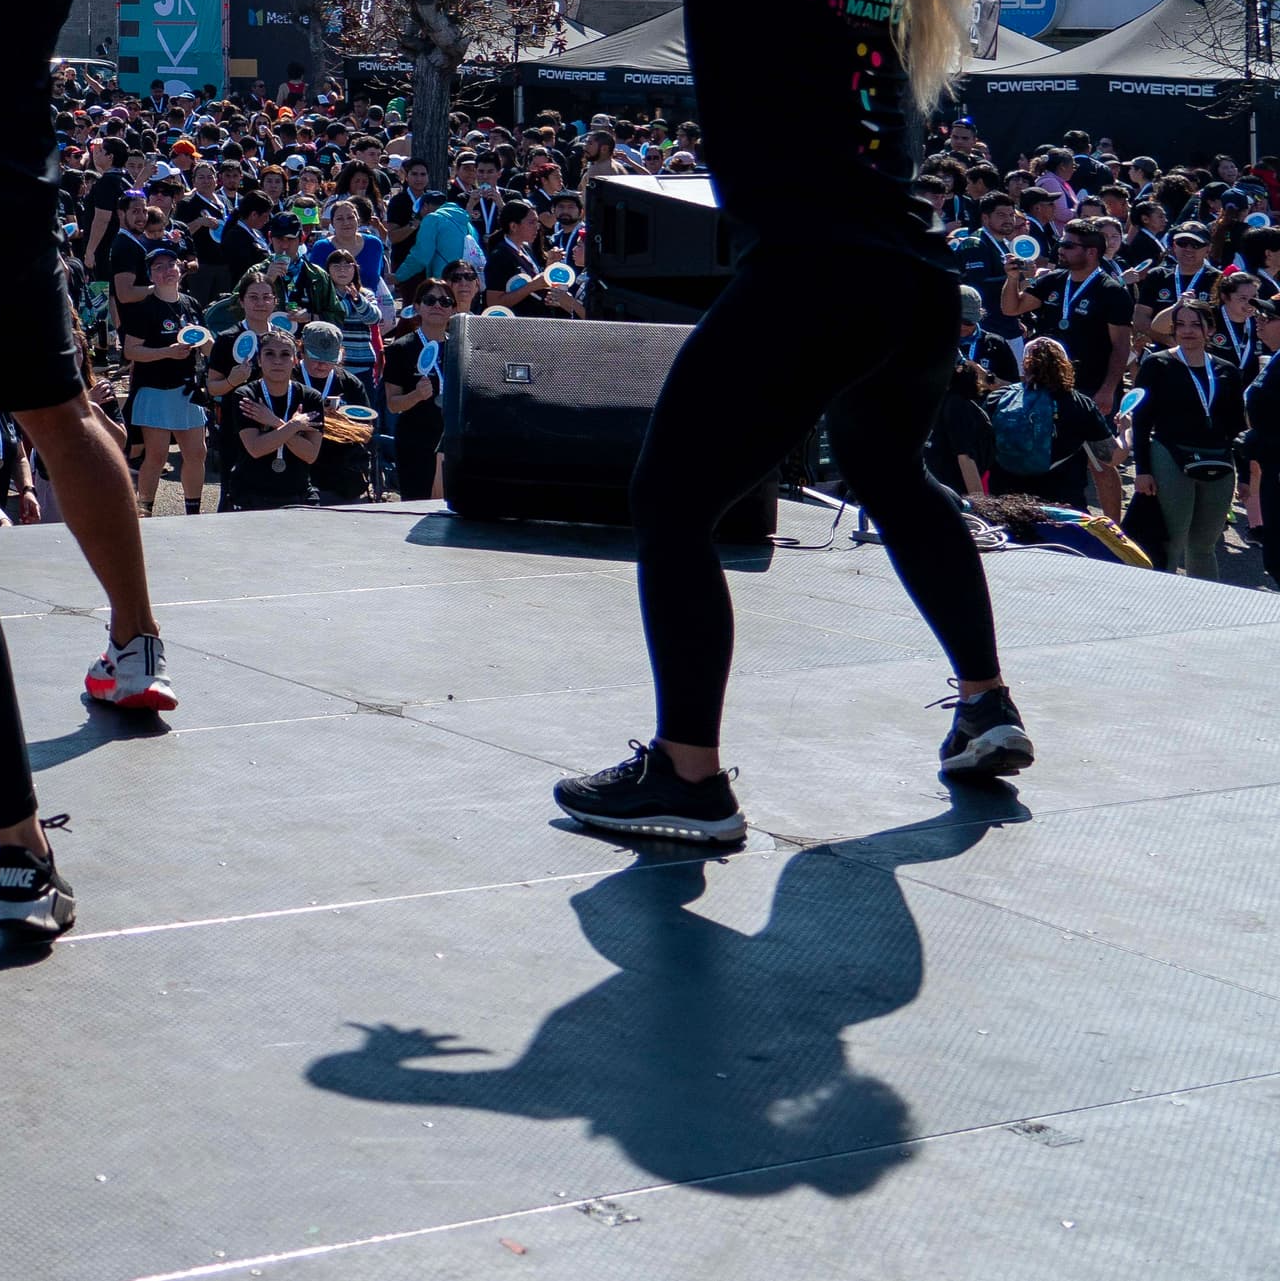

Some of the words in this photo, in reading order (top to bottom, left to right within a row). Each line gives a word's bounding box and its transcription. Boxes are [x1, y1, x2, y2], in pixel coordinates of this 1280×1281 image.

[538, 69, 607, 81] POWERADE
[624, 72, 695, 85] POWERADE
[987, 79, 1080, 93] POWERADE
[1108, 80, 1217, 97] POWERADE
